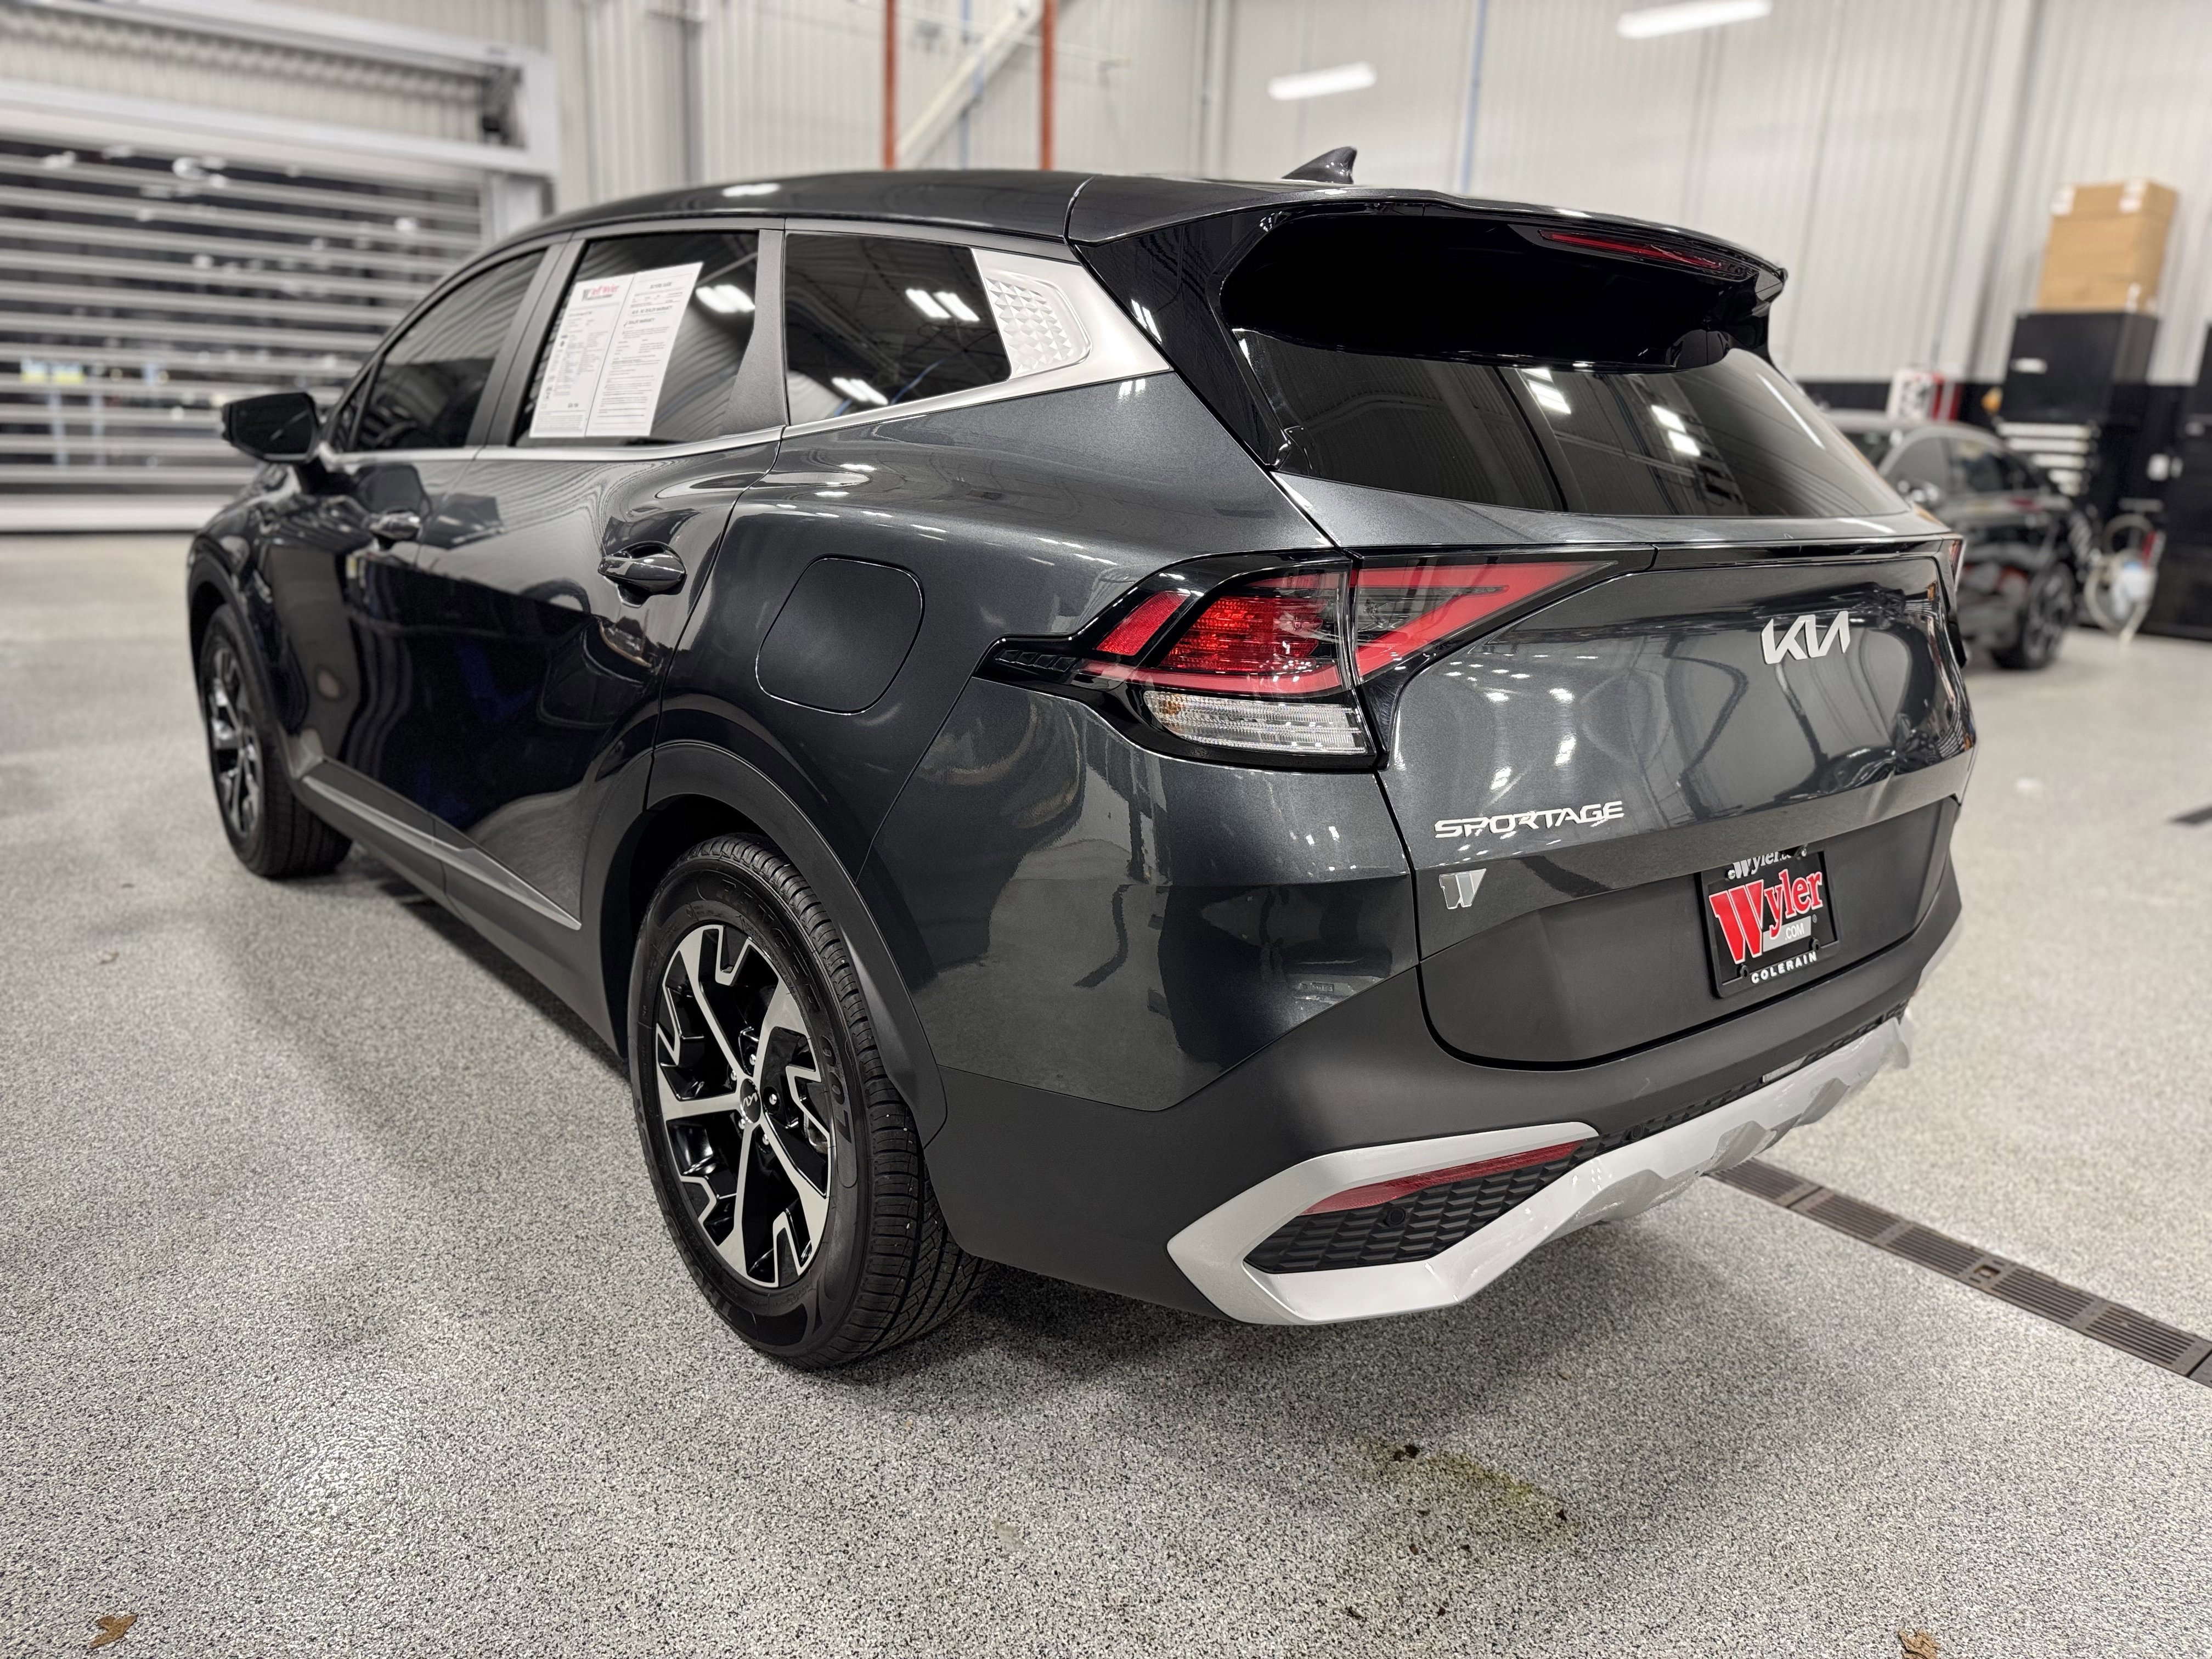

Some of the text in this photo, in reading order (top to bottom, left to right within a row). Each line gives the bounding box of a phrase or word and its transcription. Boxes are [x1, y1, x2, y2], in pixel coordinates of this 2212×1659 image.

[1761, 611, 1850, 665] KIA
[1434, 800, 1625, 839] SPORTAGE
[1709, 868, 1824, 964] Wyler
[1751, 951, 1818, 984] COLERAIN
